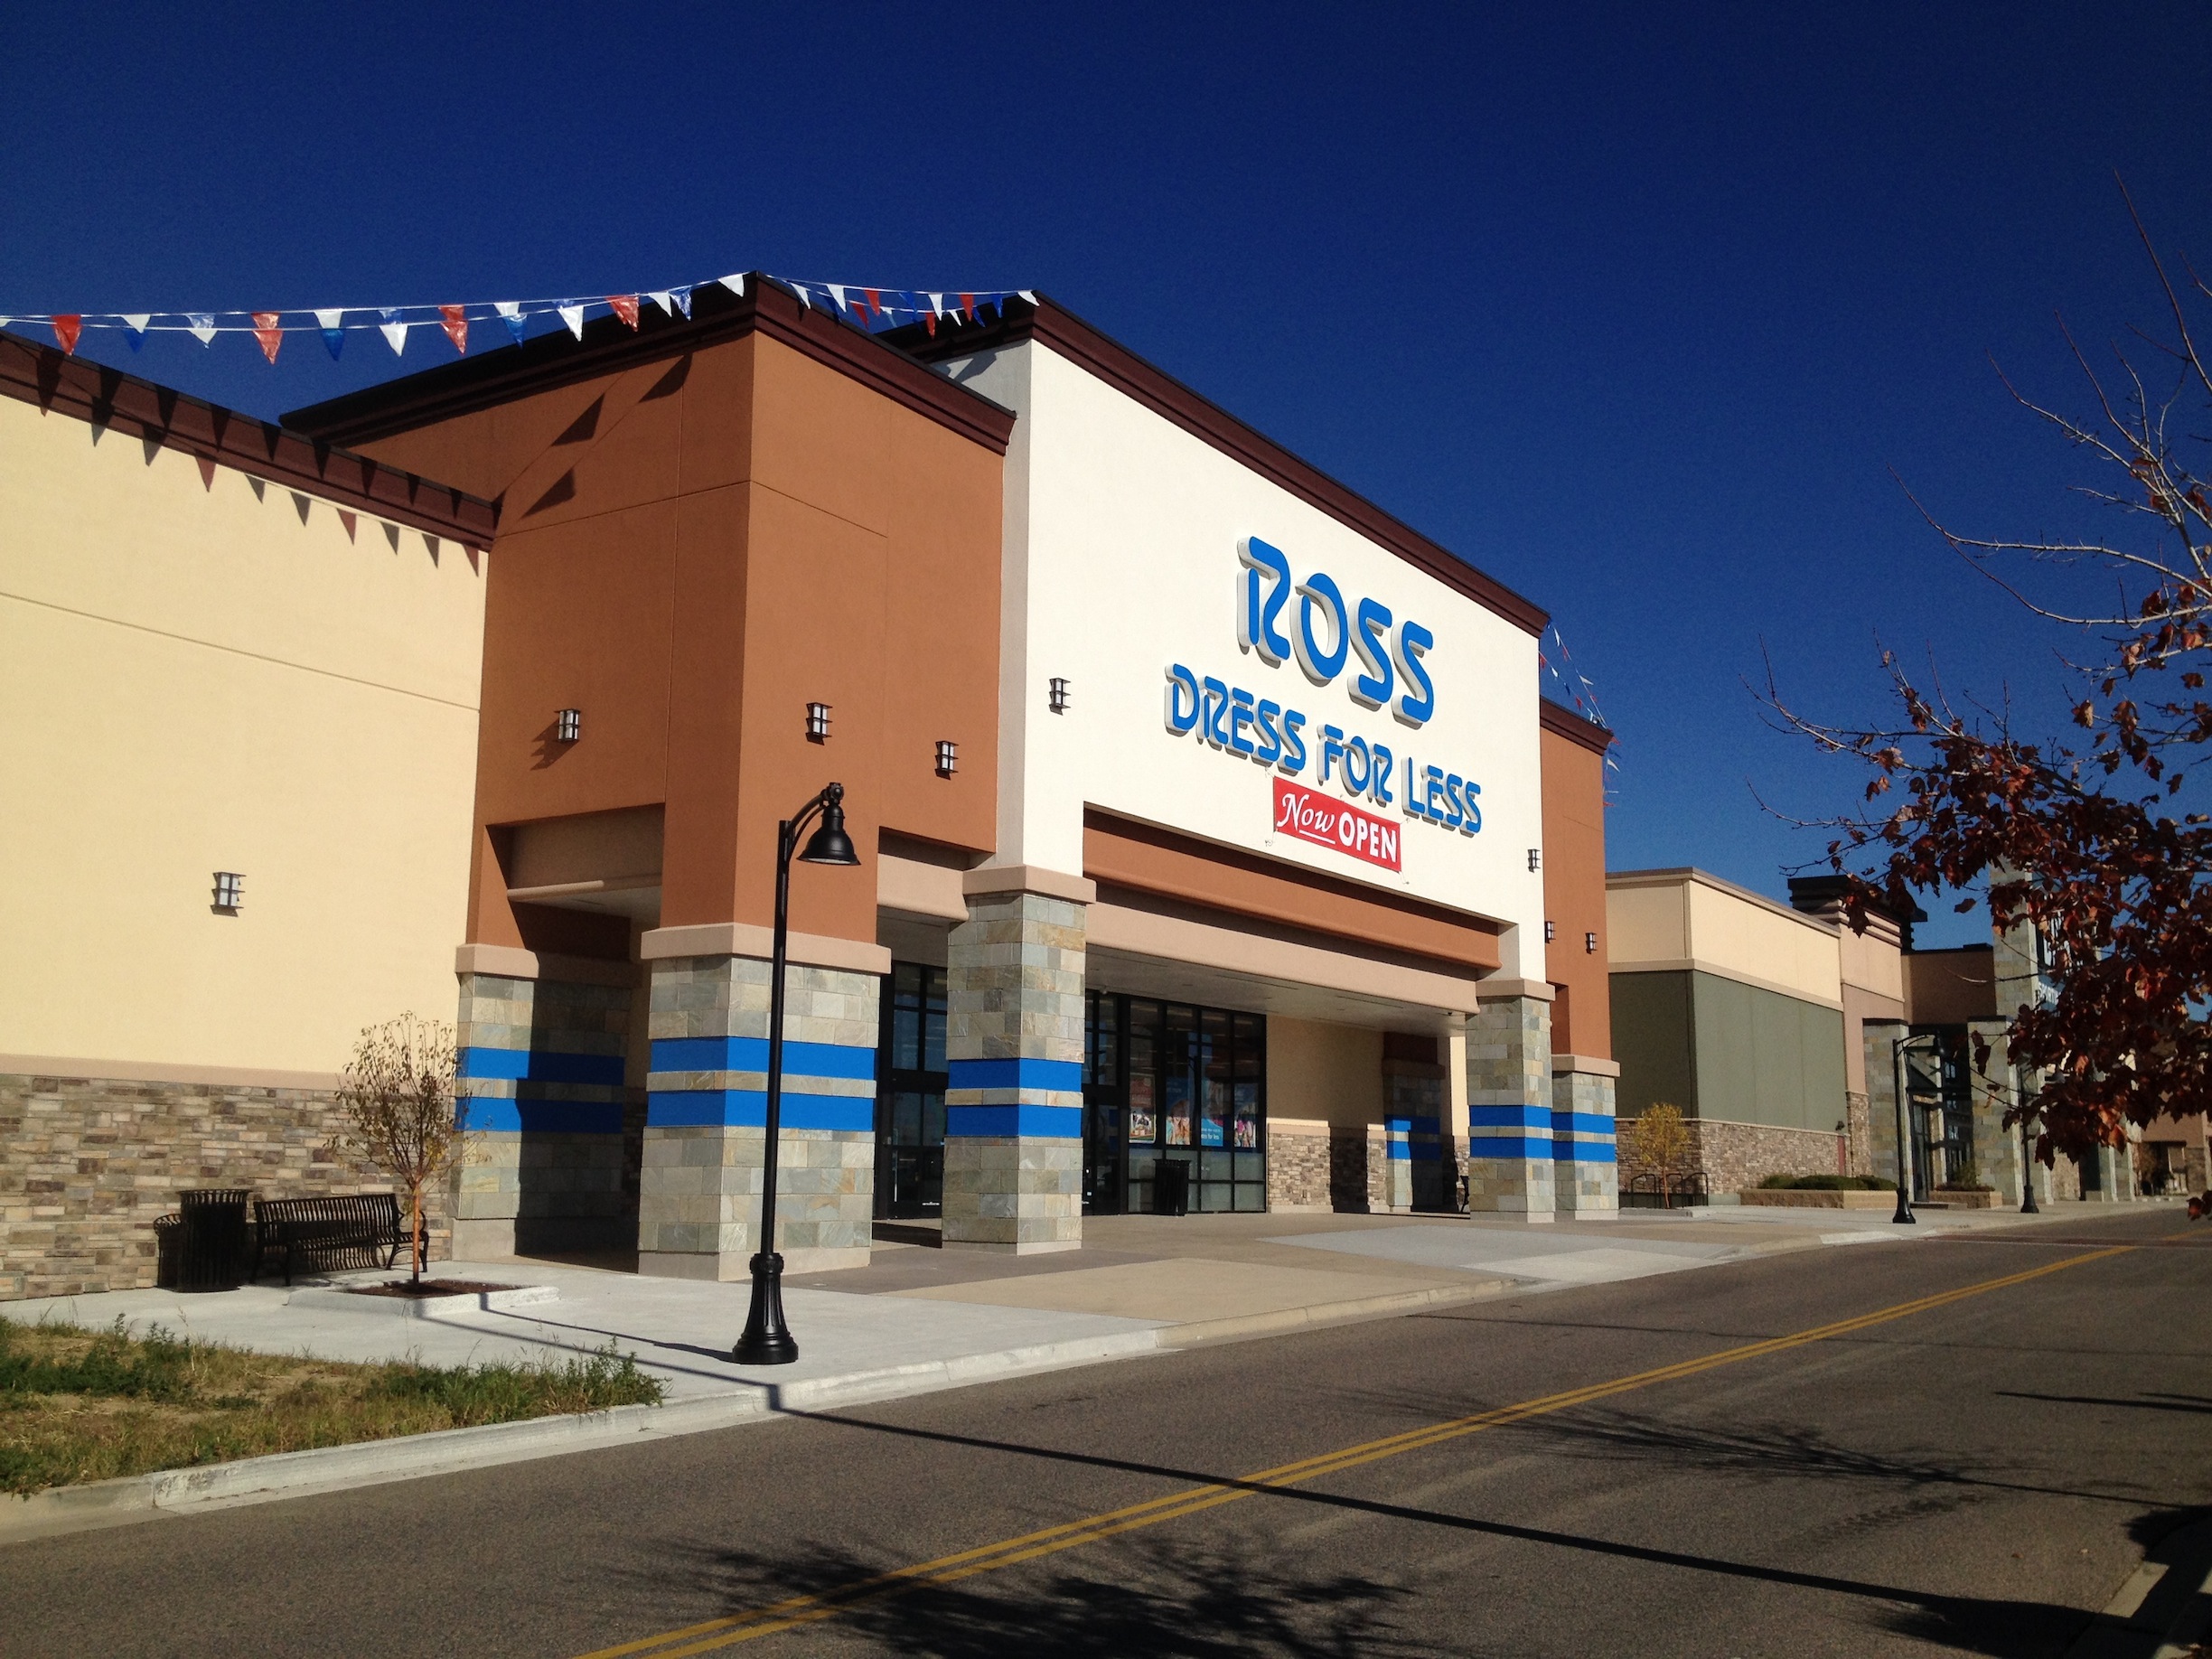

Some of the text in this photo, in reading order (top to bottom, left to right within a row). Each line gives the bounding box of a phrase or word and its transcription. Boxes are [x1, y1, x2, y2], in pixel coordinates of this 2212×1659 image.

[1239, 536, 1434, 726] ROSS
[1166, 663, 1482, 833] DRESS FOR LESS
[1276, 793, 1397, 863] Now OPEN
